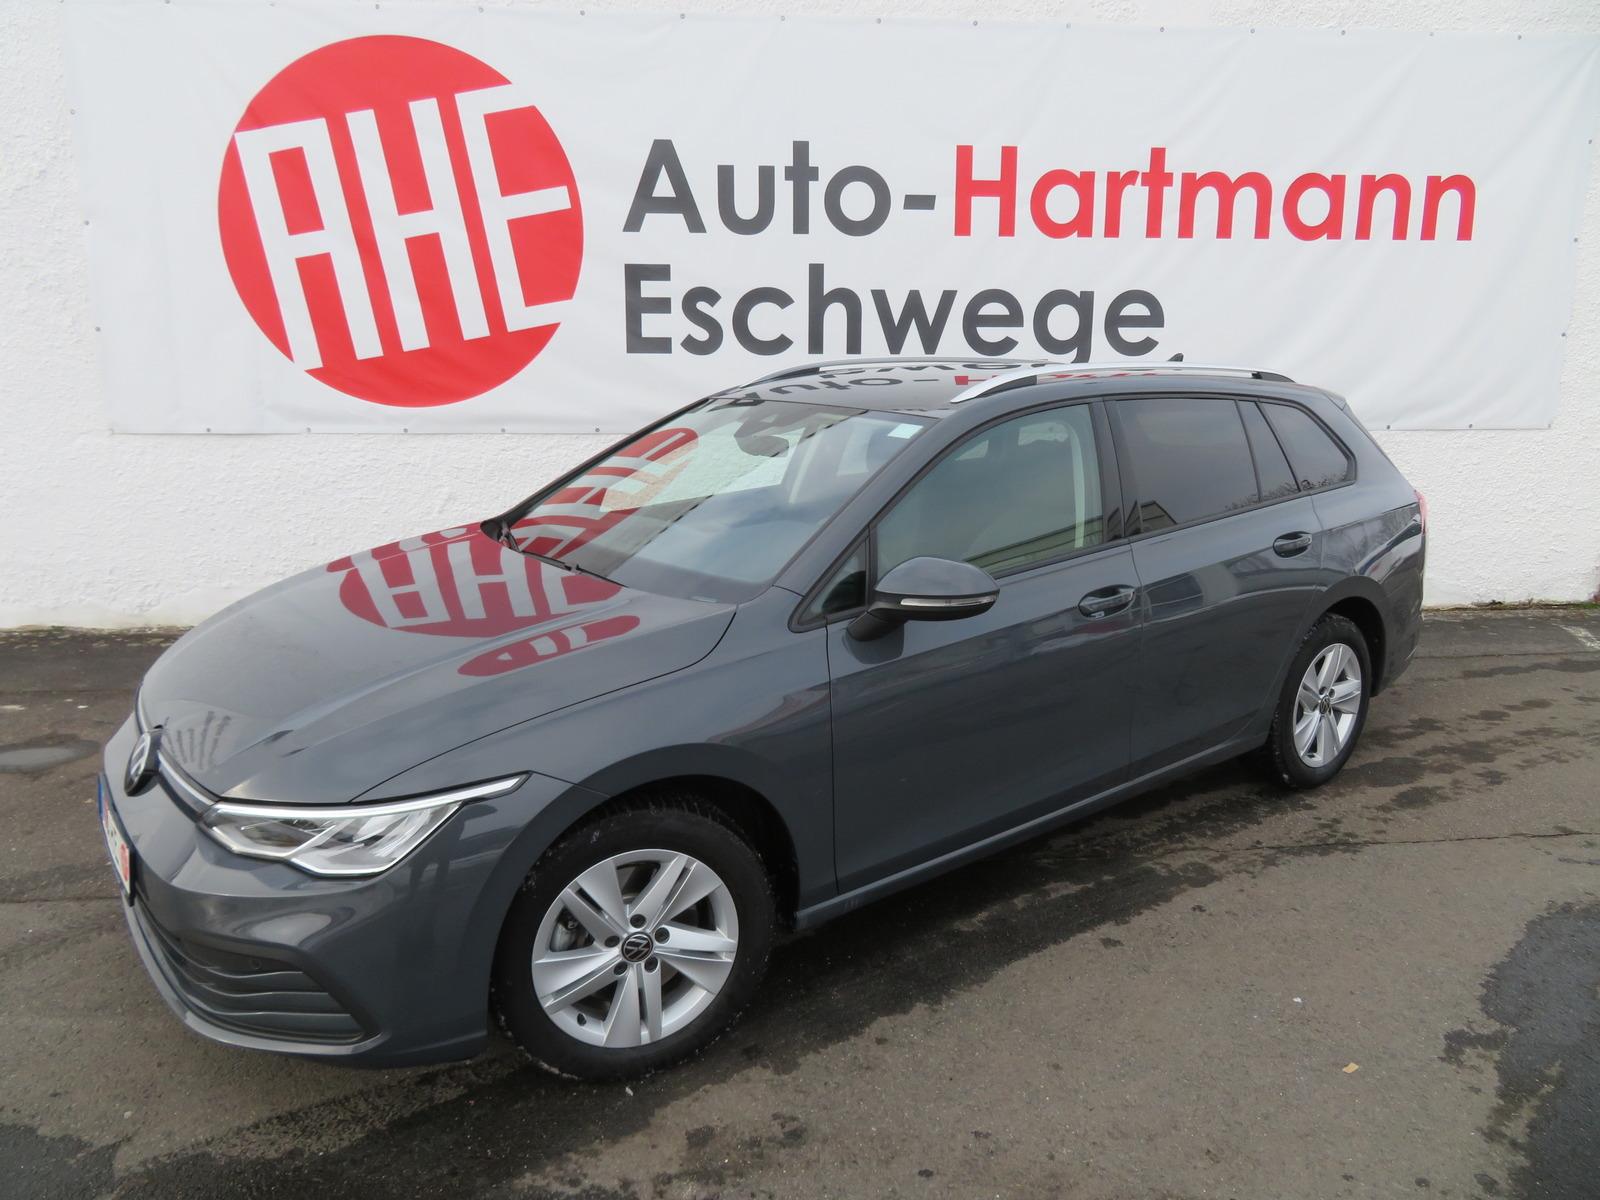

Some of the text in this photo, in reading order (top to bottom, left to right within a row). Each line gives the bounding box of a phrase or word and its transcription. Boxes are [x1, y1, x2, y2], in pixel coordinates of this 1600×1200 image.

[232, 83, 573, 370] AHE
[622, 138, 1476, 243] Auto-Hartmann
[624, 263, 1165, 363] Eschwege
